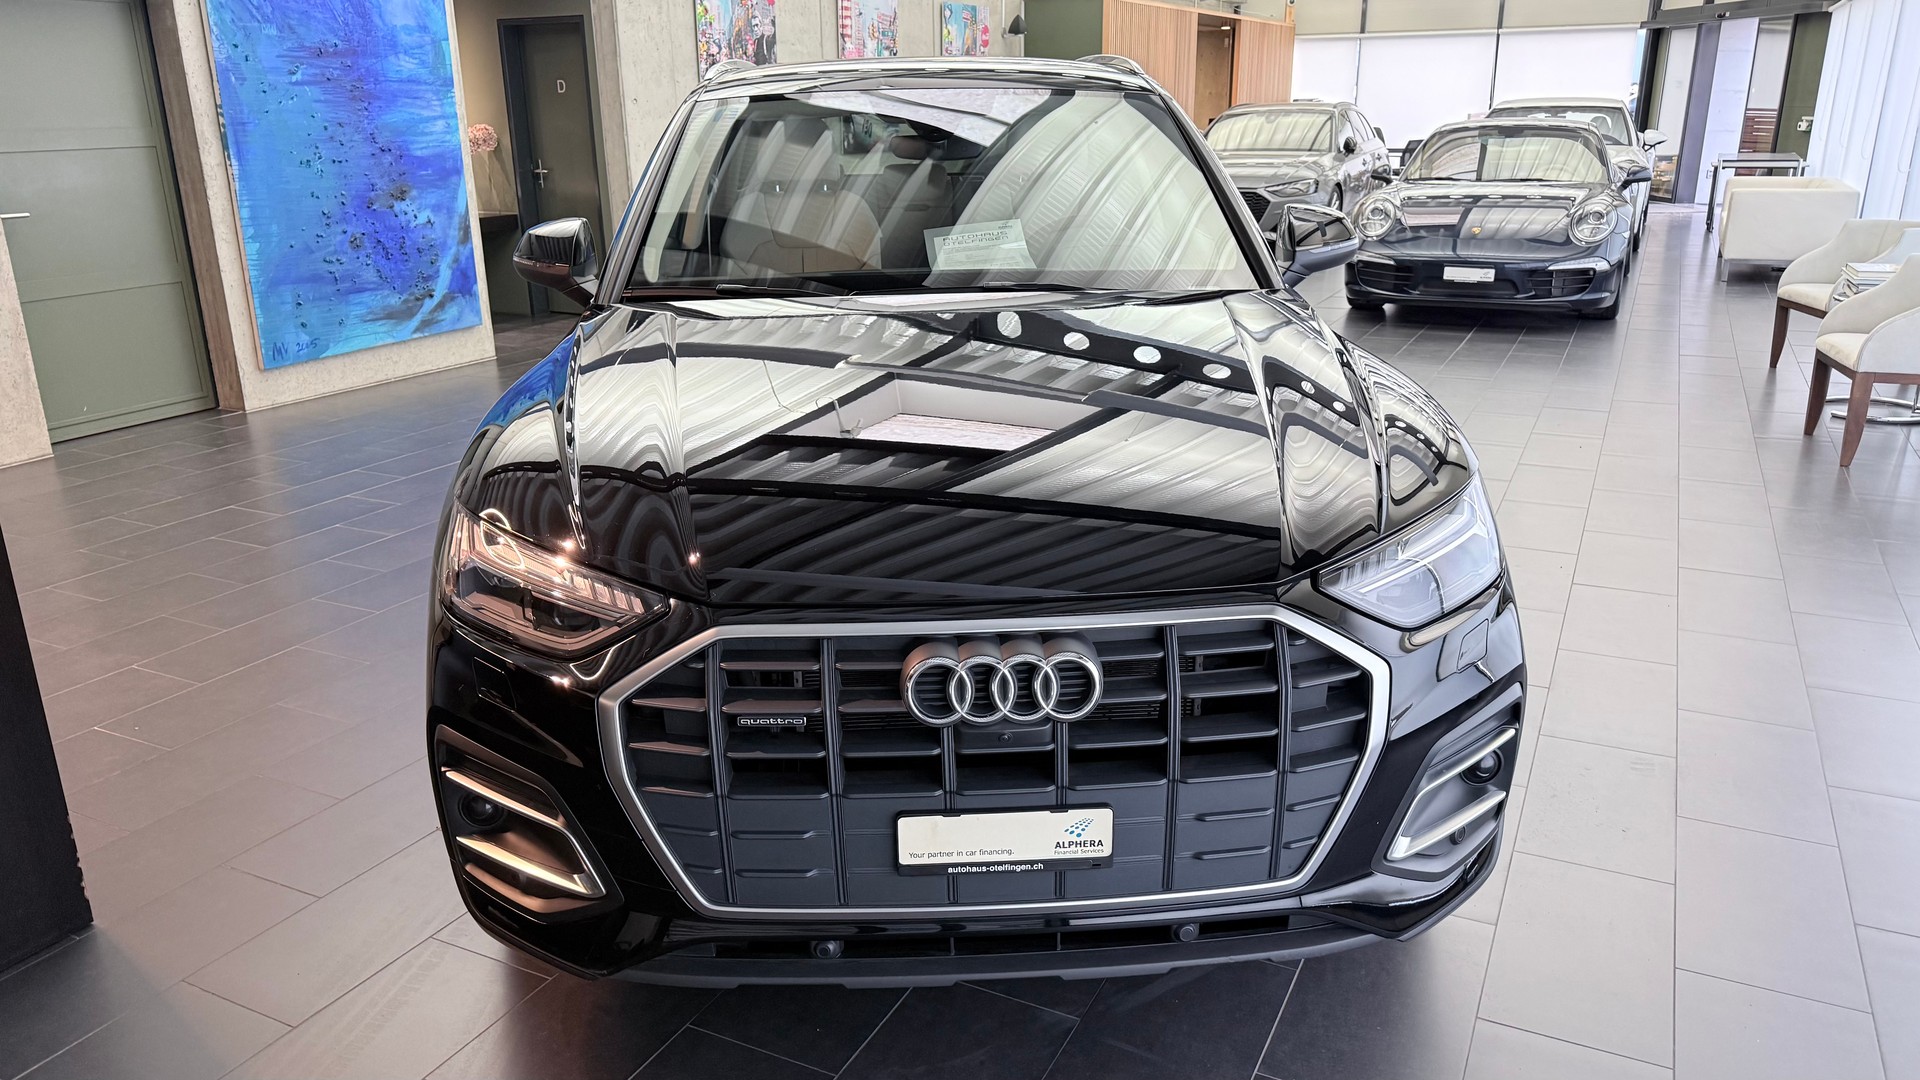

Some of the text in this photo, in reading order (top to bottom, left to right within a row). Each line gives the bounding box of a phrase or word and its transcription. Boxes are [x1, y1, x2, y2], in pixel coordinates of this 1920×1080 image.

[557, 80, 566, 93] D
[943, 231, 1008, 241] AUTOHAUS
[1054, 839, 1104, 849] ALPHERA
[927, 850, 954, 859] partner
[965, 849, 977, 857] car
[979, 848, 1015, 856] financing.
[948, 863, 1043, 873] autohaus-otelfingen.ch
